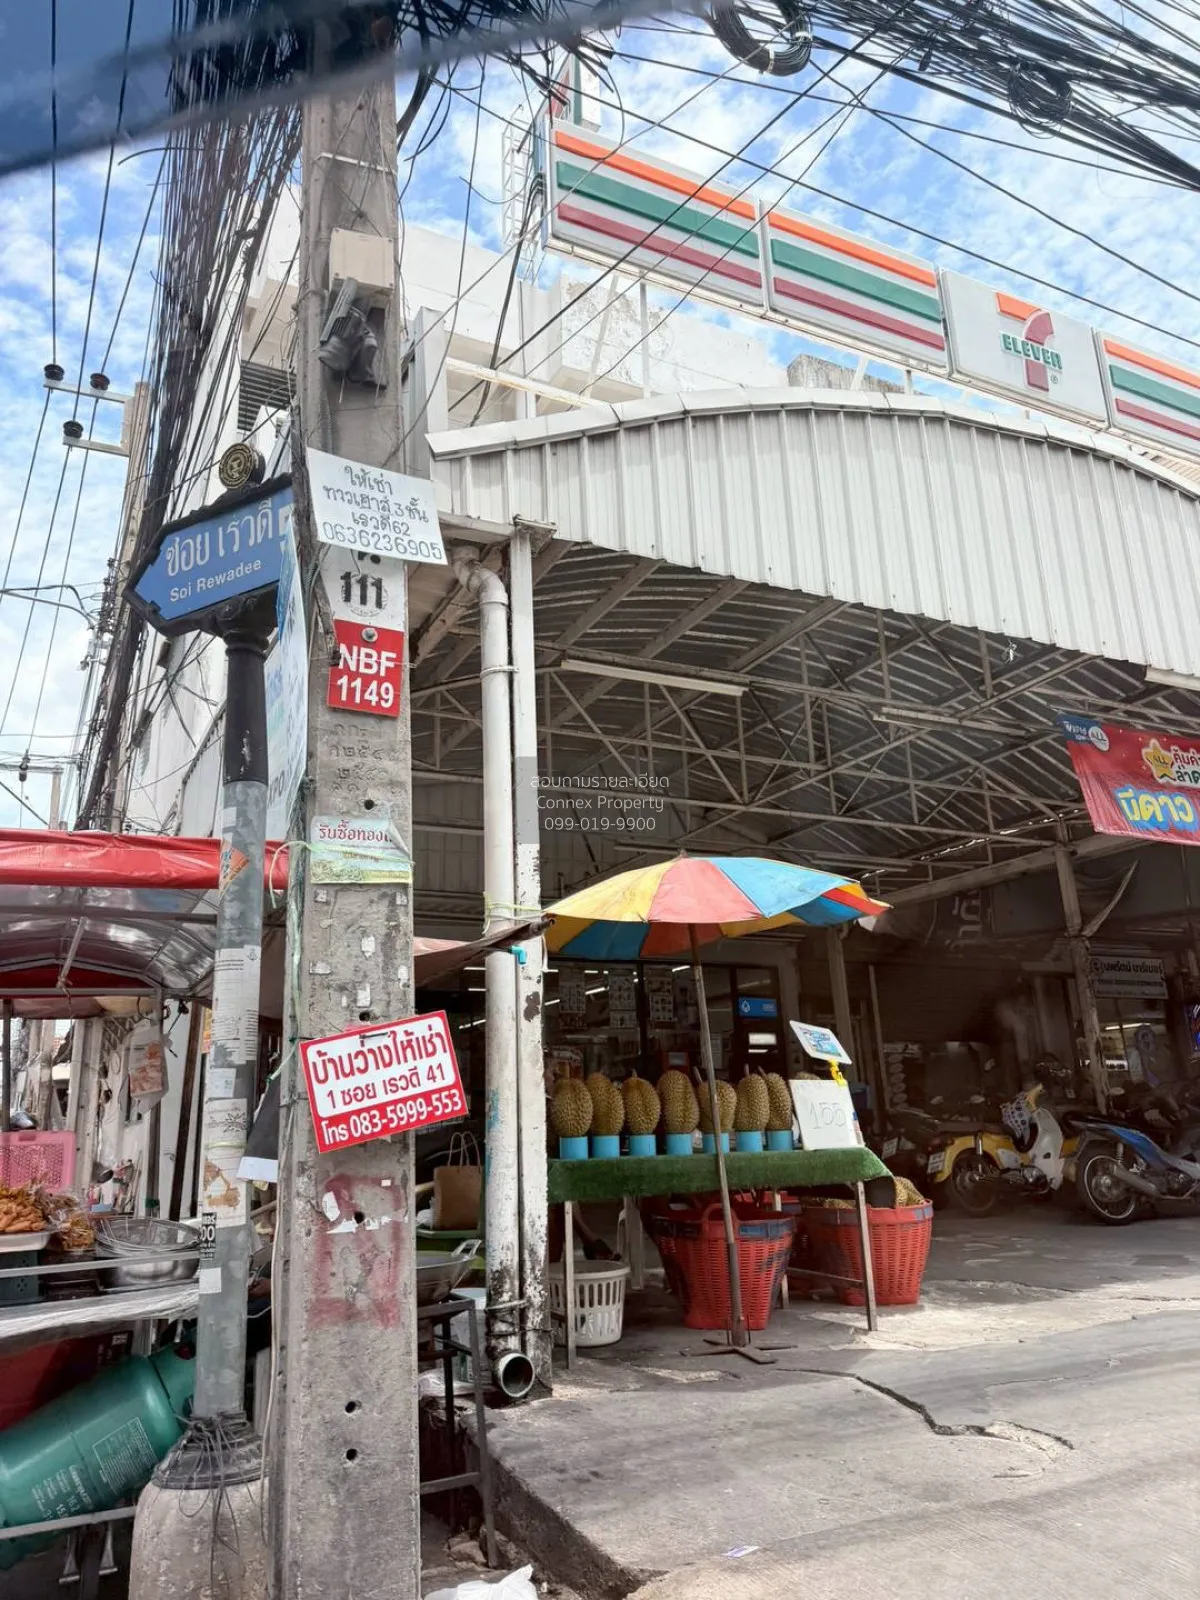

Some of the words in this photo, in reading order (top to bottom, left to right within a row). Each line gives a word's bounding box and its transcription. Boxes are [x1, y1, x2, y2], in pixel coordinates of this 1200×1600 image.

[344, 465, 393, 496] ให้เช่า
[166, 533, 210, 577] ซอย
[217, 497, 273, 558] เรวดี
[322, 521, 443, 560] 0636236905
[170, 582, 192, 602] Soi
[196, 559, 262, 593] Rewadee
[340, 571, 383, 610] 111
[338, 643, 397, 677] NBF
[337, 674, 394, 708] 1149
[319, 819, 394, 842] รับซื้อทองเ
[312, 1024, 447, 1085] บ้านว่างให้เช่า
[327, 1090, 337, 1109] 1
[341, 1082, 377, 1106] ซอย
[382, 1066, 421, 1095] เรวดี
[426, 1062, 445, 1084] 41
[321, 1120, 349, 1145] โทร
[350, 1088, 462, 1138] 083-5999-553
